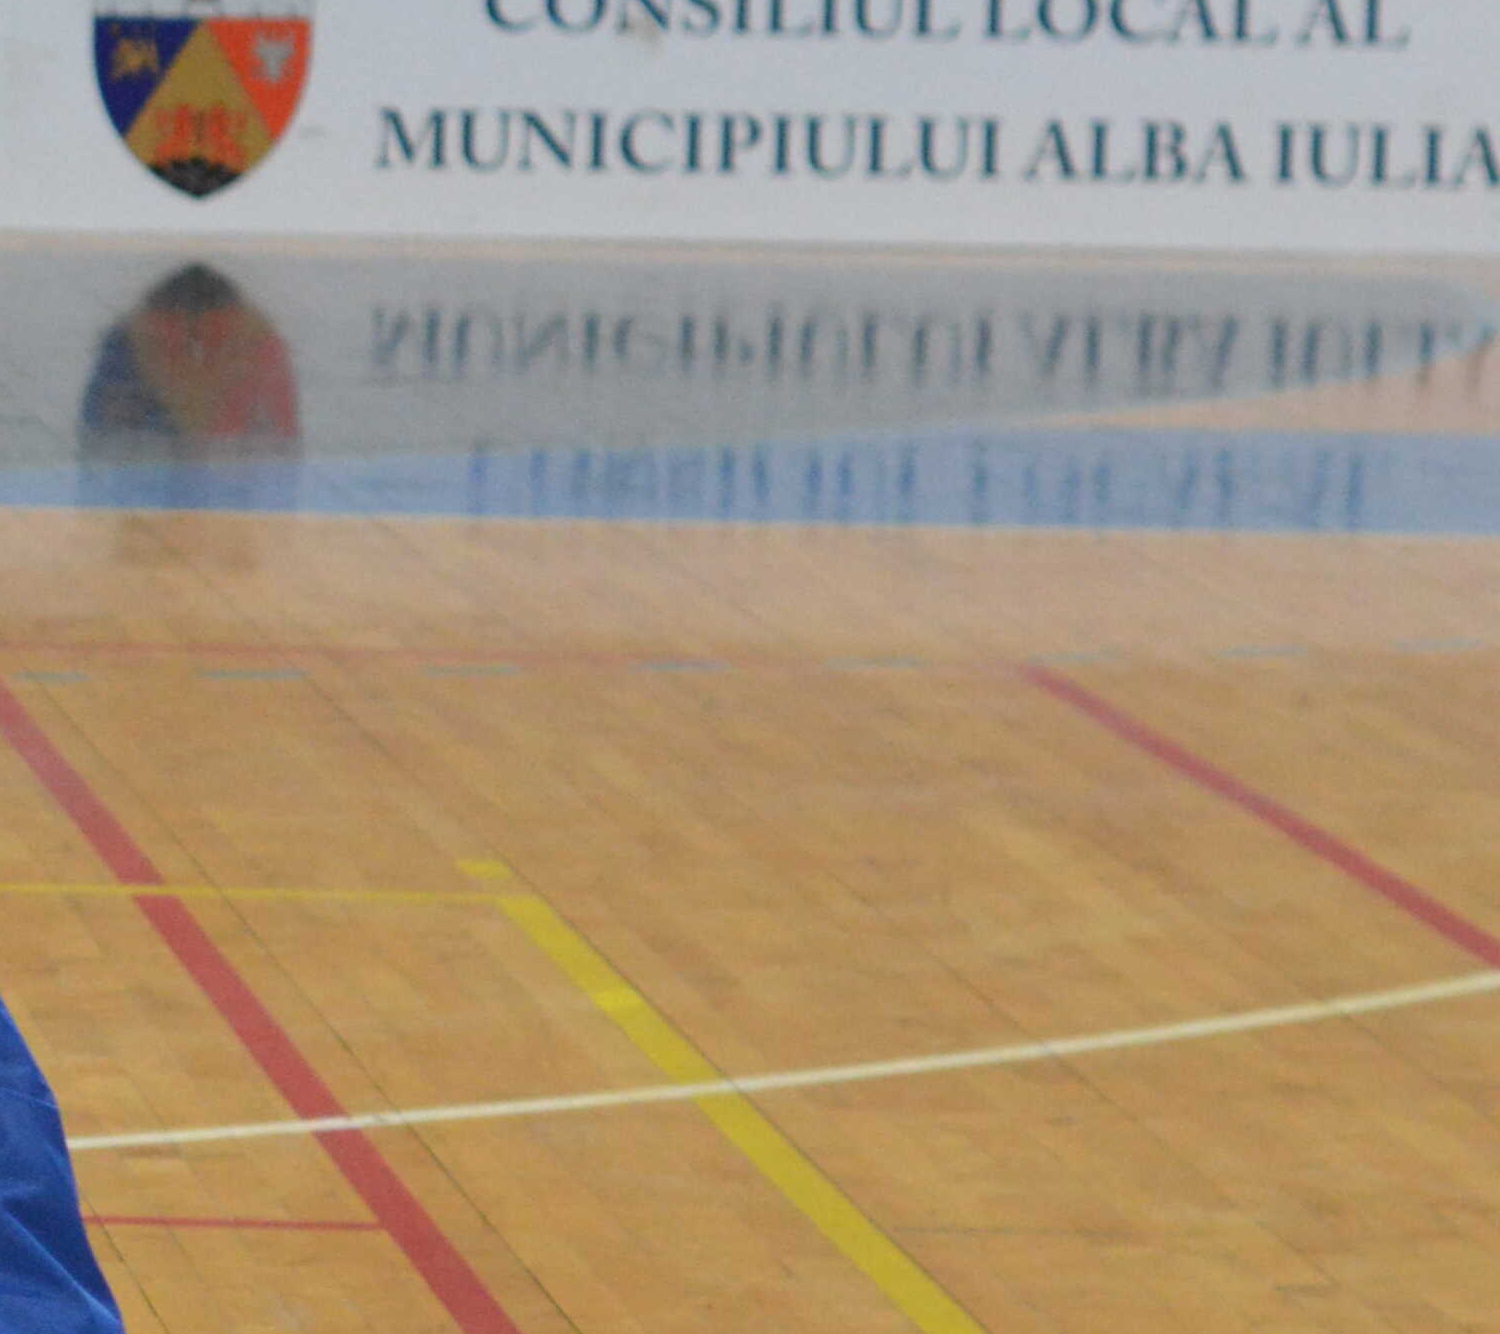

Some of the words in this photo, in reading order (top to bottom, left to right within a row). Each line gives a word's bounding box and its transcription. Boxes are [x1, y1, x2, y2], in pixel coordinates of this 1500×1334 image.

[373, 104, 1002, 181] MUNICIPIULUI
[1021, 117, 1249, 186] ALBA
[1272, 120, 1500, 191] IULIA
